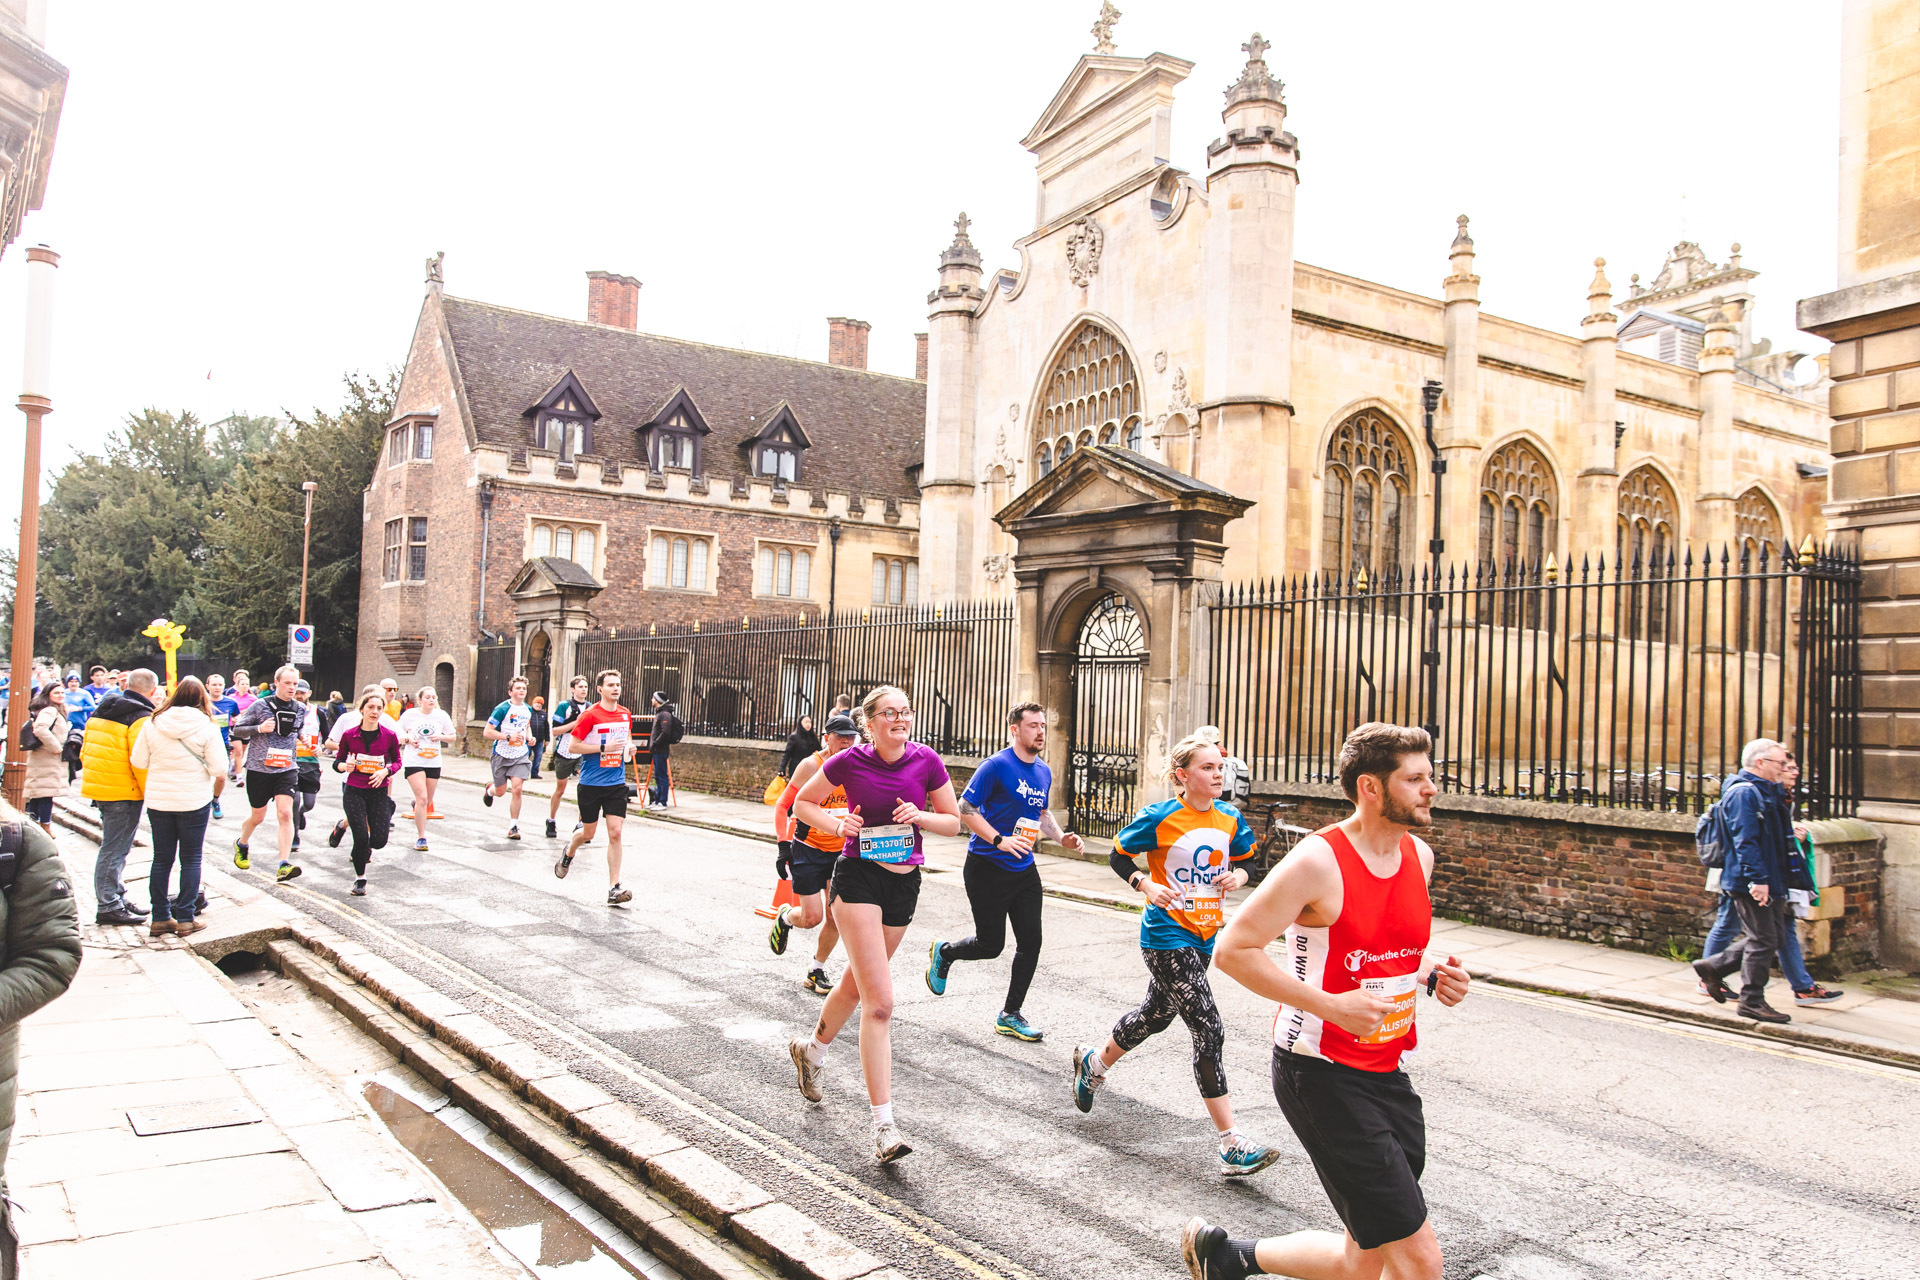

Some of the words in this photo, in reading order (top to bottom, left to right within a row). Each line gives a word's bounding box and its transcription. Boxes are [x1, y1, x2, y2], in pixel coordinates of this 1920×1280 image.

[871, 840, 903, 849] B.13707
[1196, 902, 1219, 910] B.8363
[1295, 935, 1308, 952] DO
[1367, 953, 1385, 963] Save
[1385, 950, 1400, 960] the
